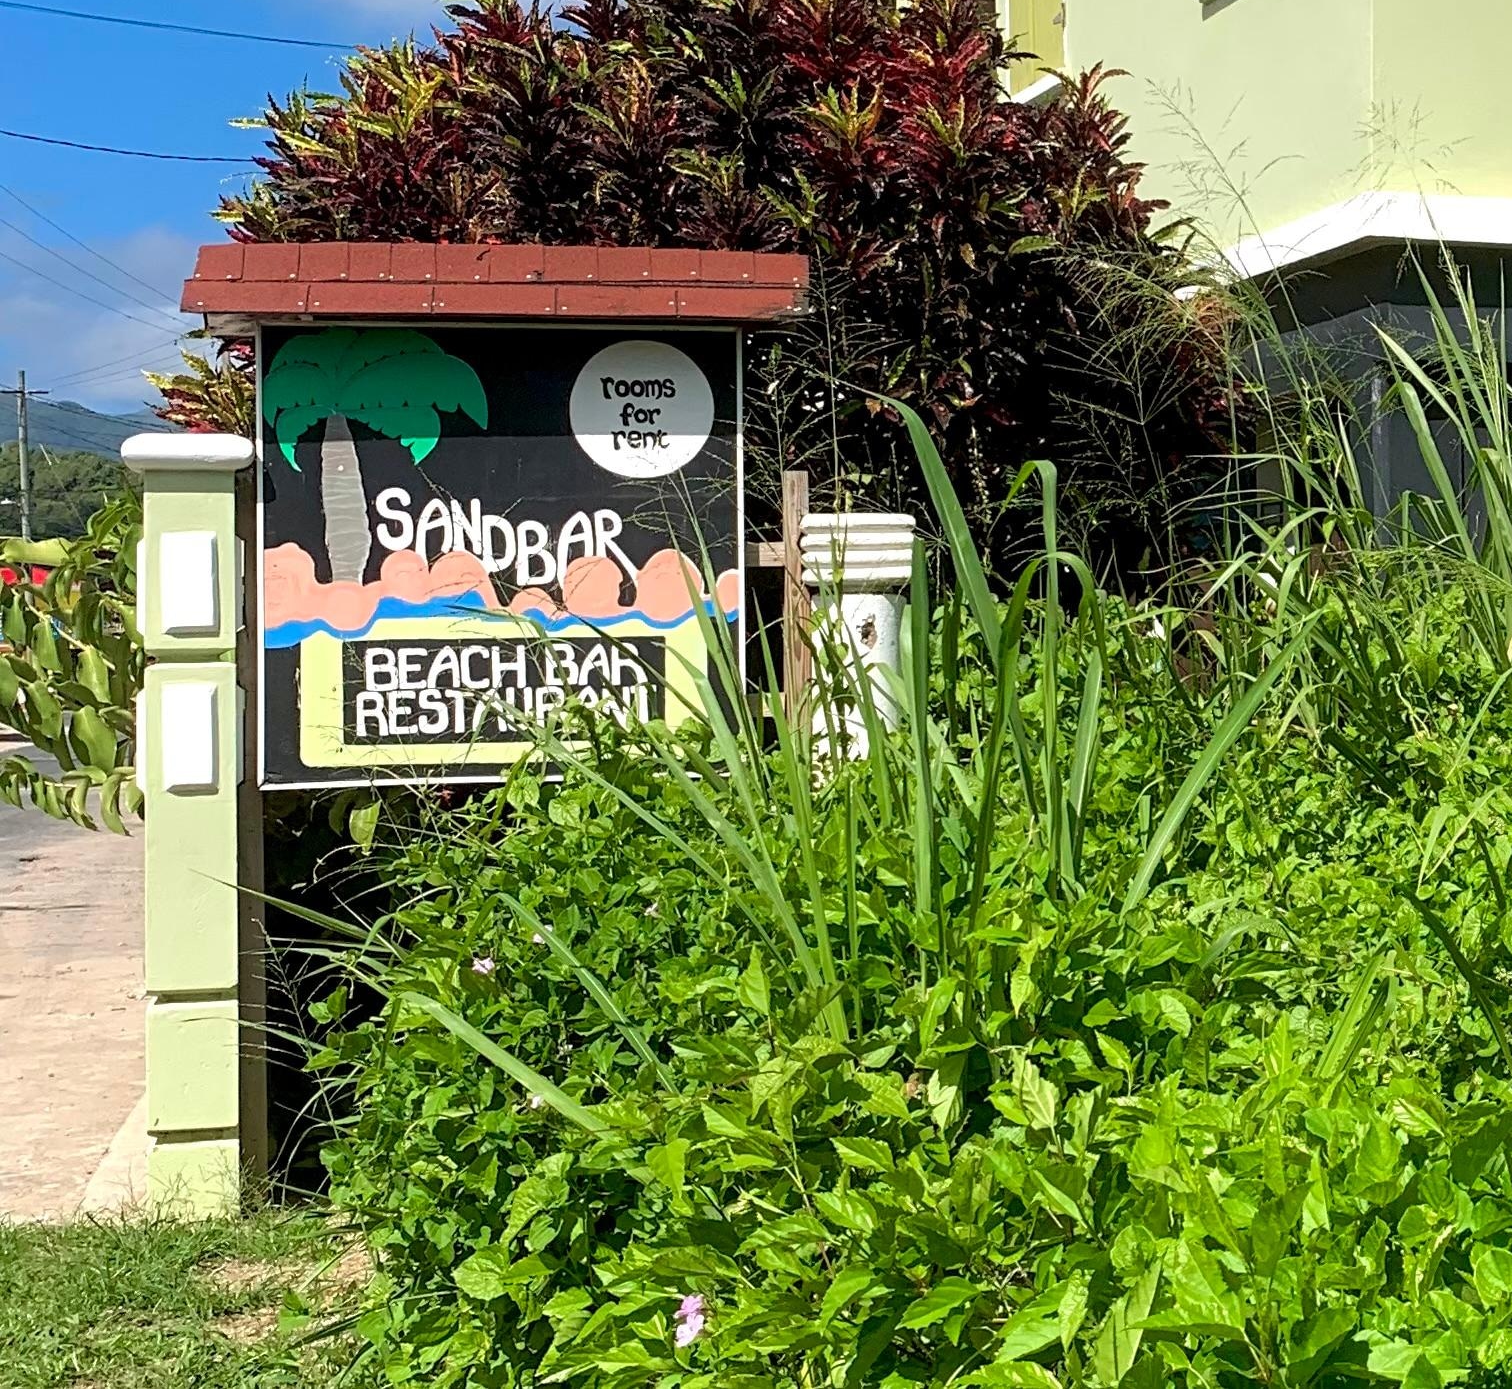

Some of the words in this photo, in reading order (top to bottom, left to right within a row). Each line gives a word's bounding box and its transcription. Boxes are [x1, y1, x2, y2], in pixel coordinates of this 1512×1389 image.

[600, 377, 676, 399] rooms
[620, 403, 661, 426] for
[611, 430, 670, 450] rent
[376, 487, 640, 585] SANDBAR
[365, 645, 526, 691] BEACH
[545, 643, 648, 686] BAR
